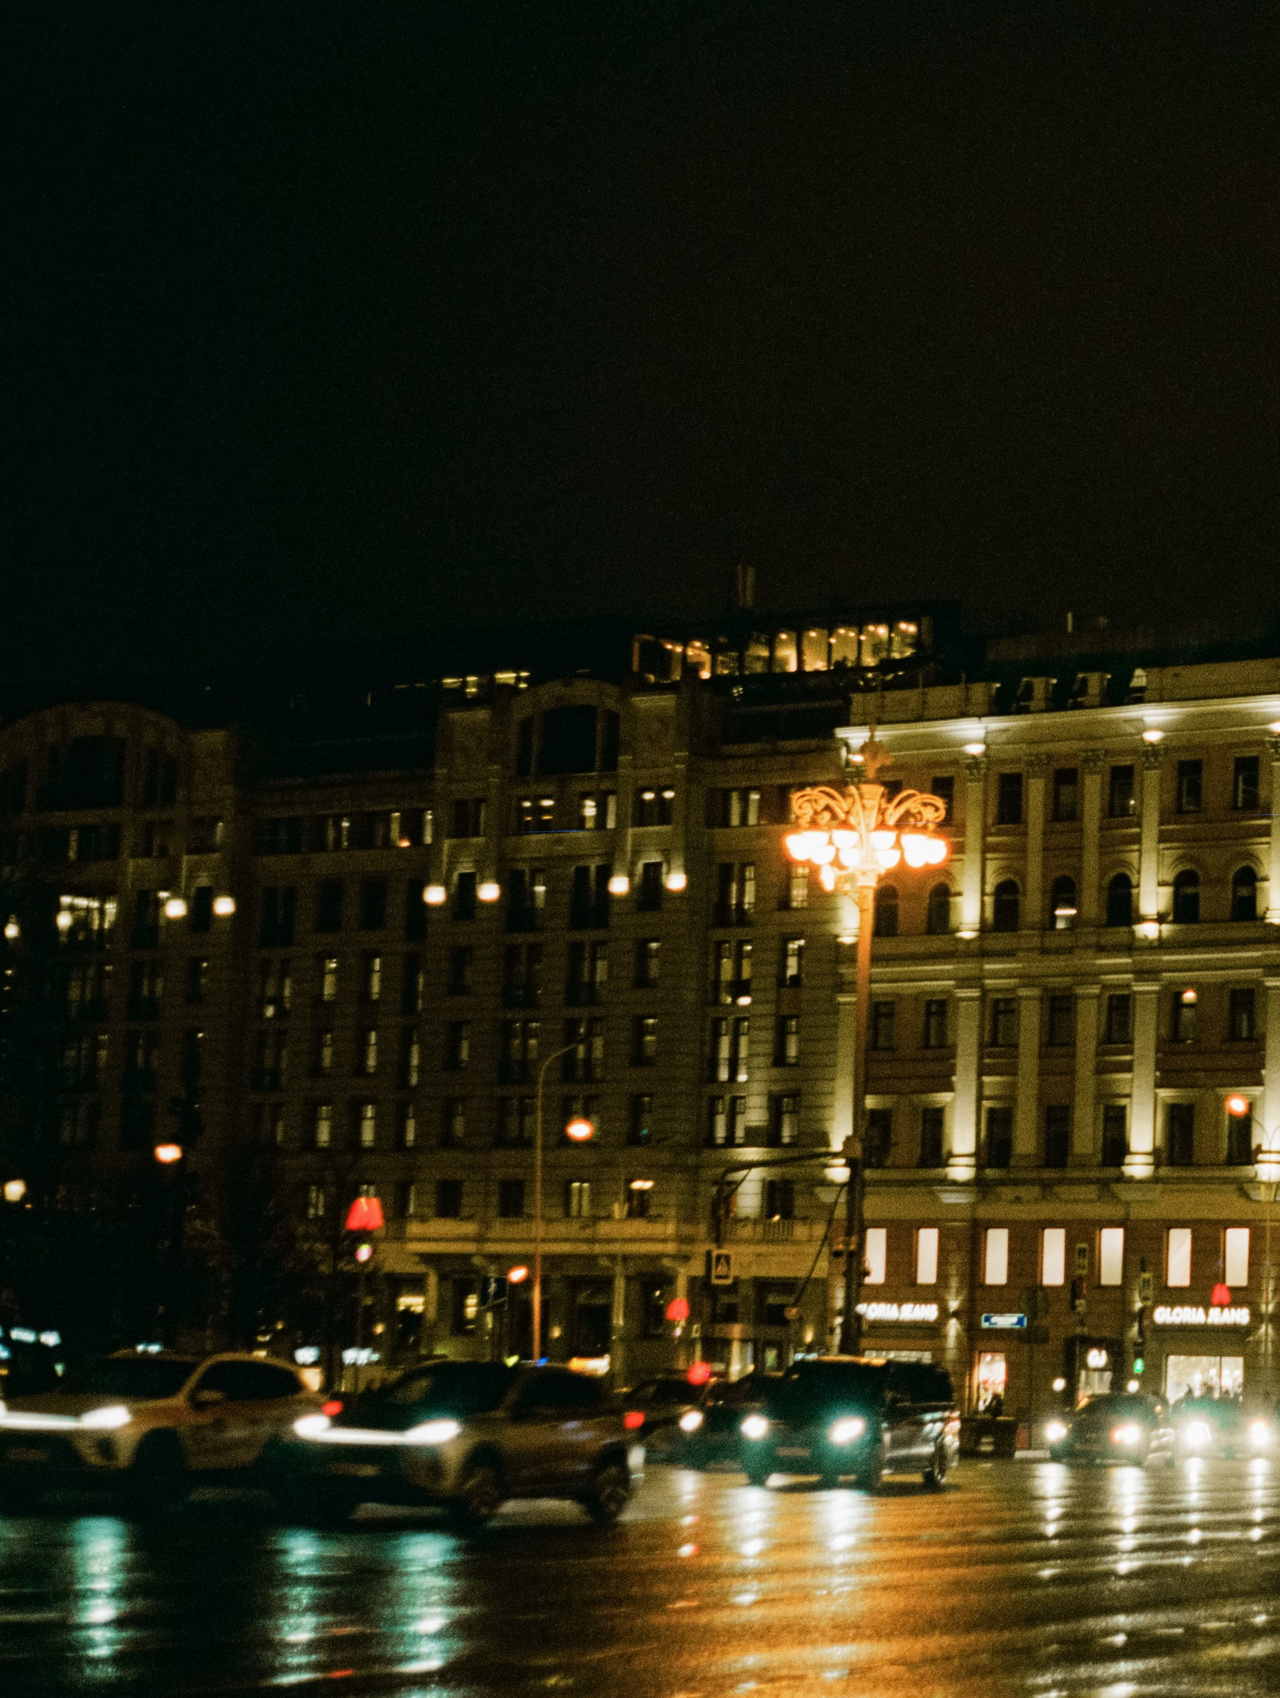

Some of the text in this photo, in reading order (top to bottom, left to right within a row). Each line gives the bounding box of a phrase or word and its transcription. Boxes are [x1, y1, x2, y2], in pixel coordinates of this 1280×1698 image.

[899, 1302, 939, 1322] JEANS
[1153, 1305, 1250, 1326] GLORIA JEANS
